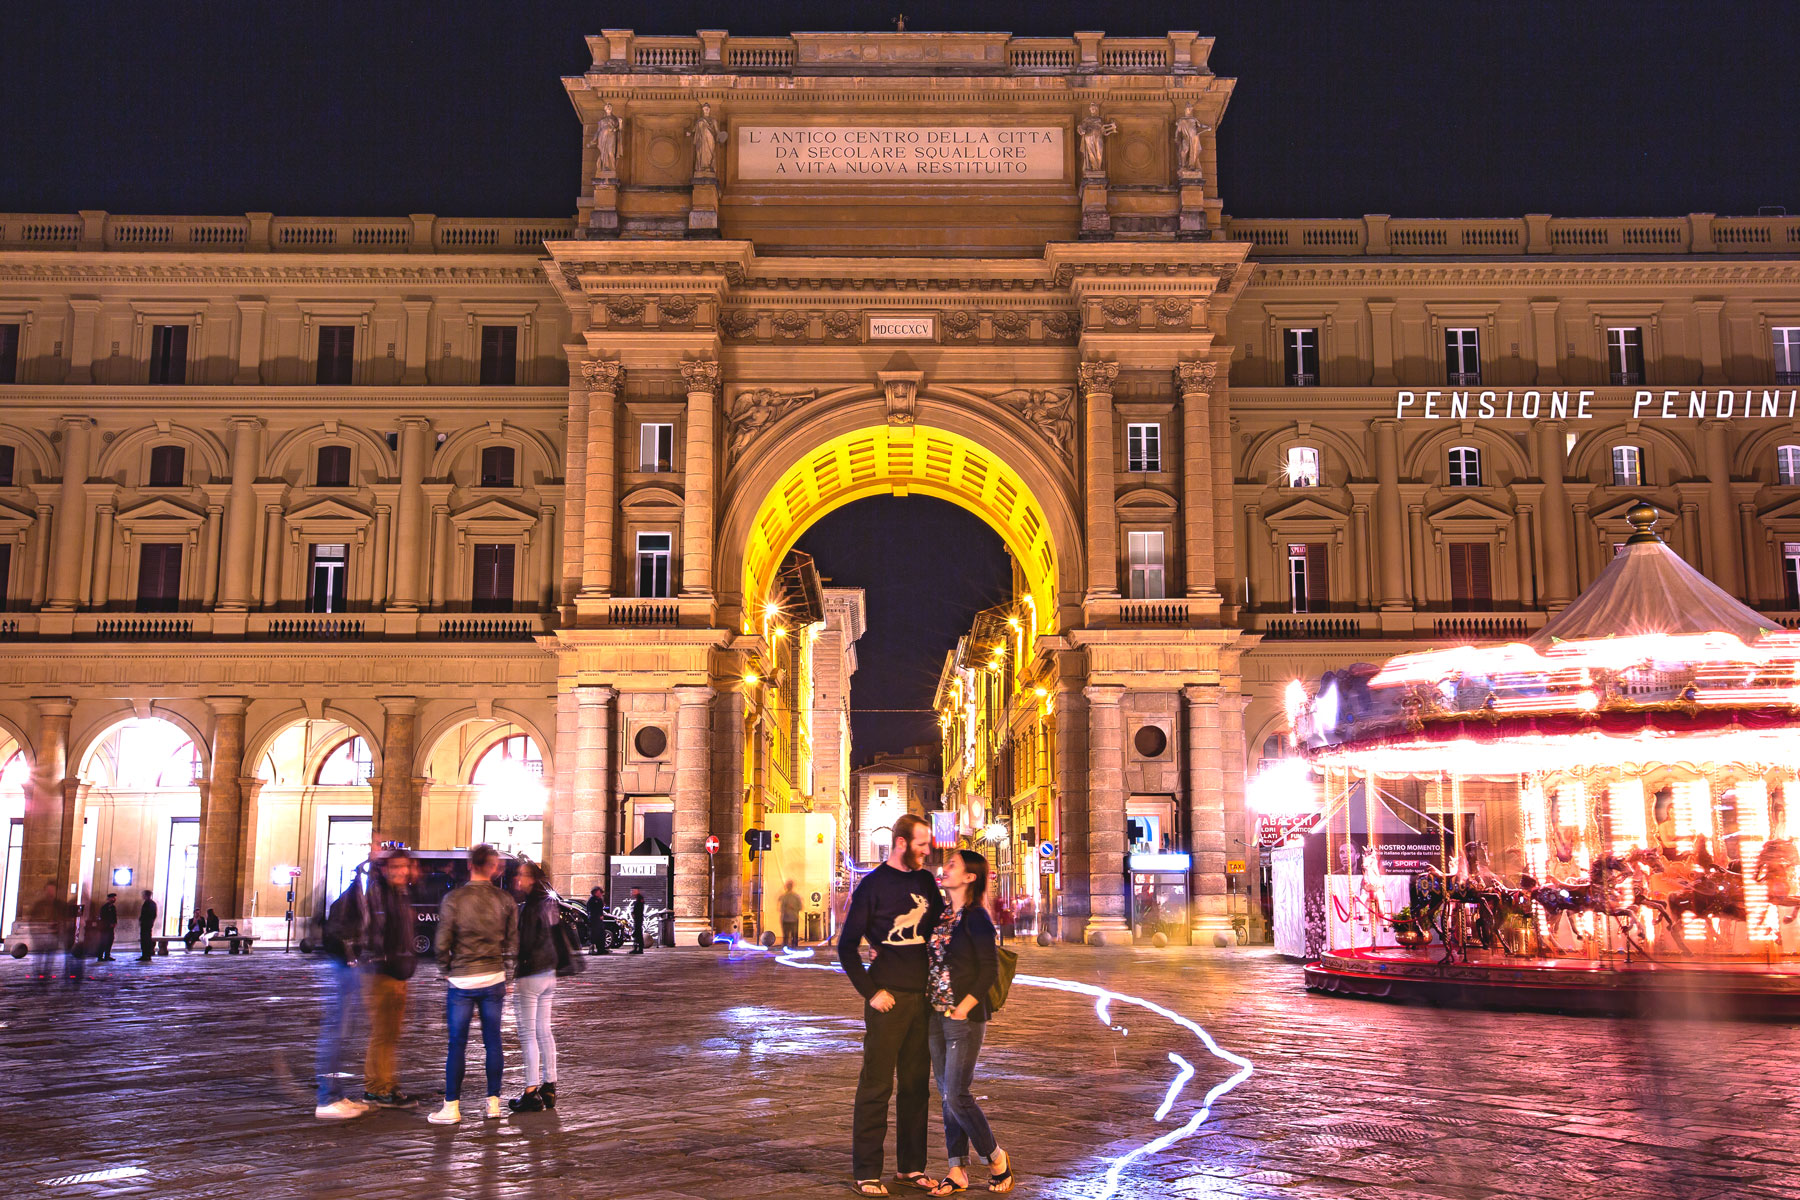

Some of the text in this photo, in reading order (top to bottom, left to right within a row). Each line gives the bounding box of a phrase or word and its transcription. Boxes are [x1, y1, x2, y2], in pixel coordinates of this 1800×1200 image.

[770, 131, 836, 143] ANTICO
[844, 131, 919, 143] CENTRO
[927, 131, 989, 143] DELLA
[776, 146, 1026, 159] DA SECOLARE SQUALLORE
[776, 162, 1027, 173] A VITA NUOVA RESTITUITO
[873, 324, 928, 334] MDCCCXCV
[1396, 390, 1797, 419] PENSIONE PENDINI
[1257, 817, 1312, 826] ABACCHI
[417, 913, 440, 922] CAR
